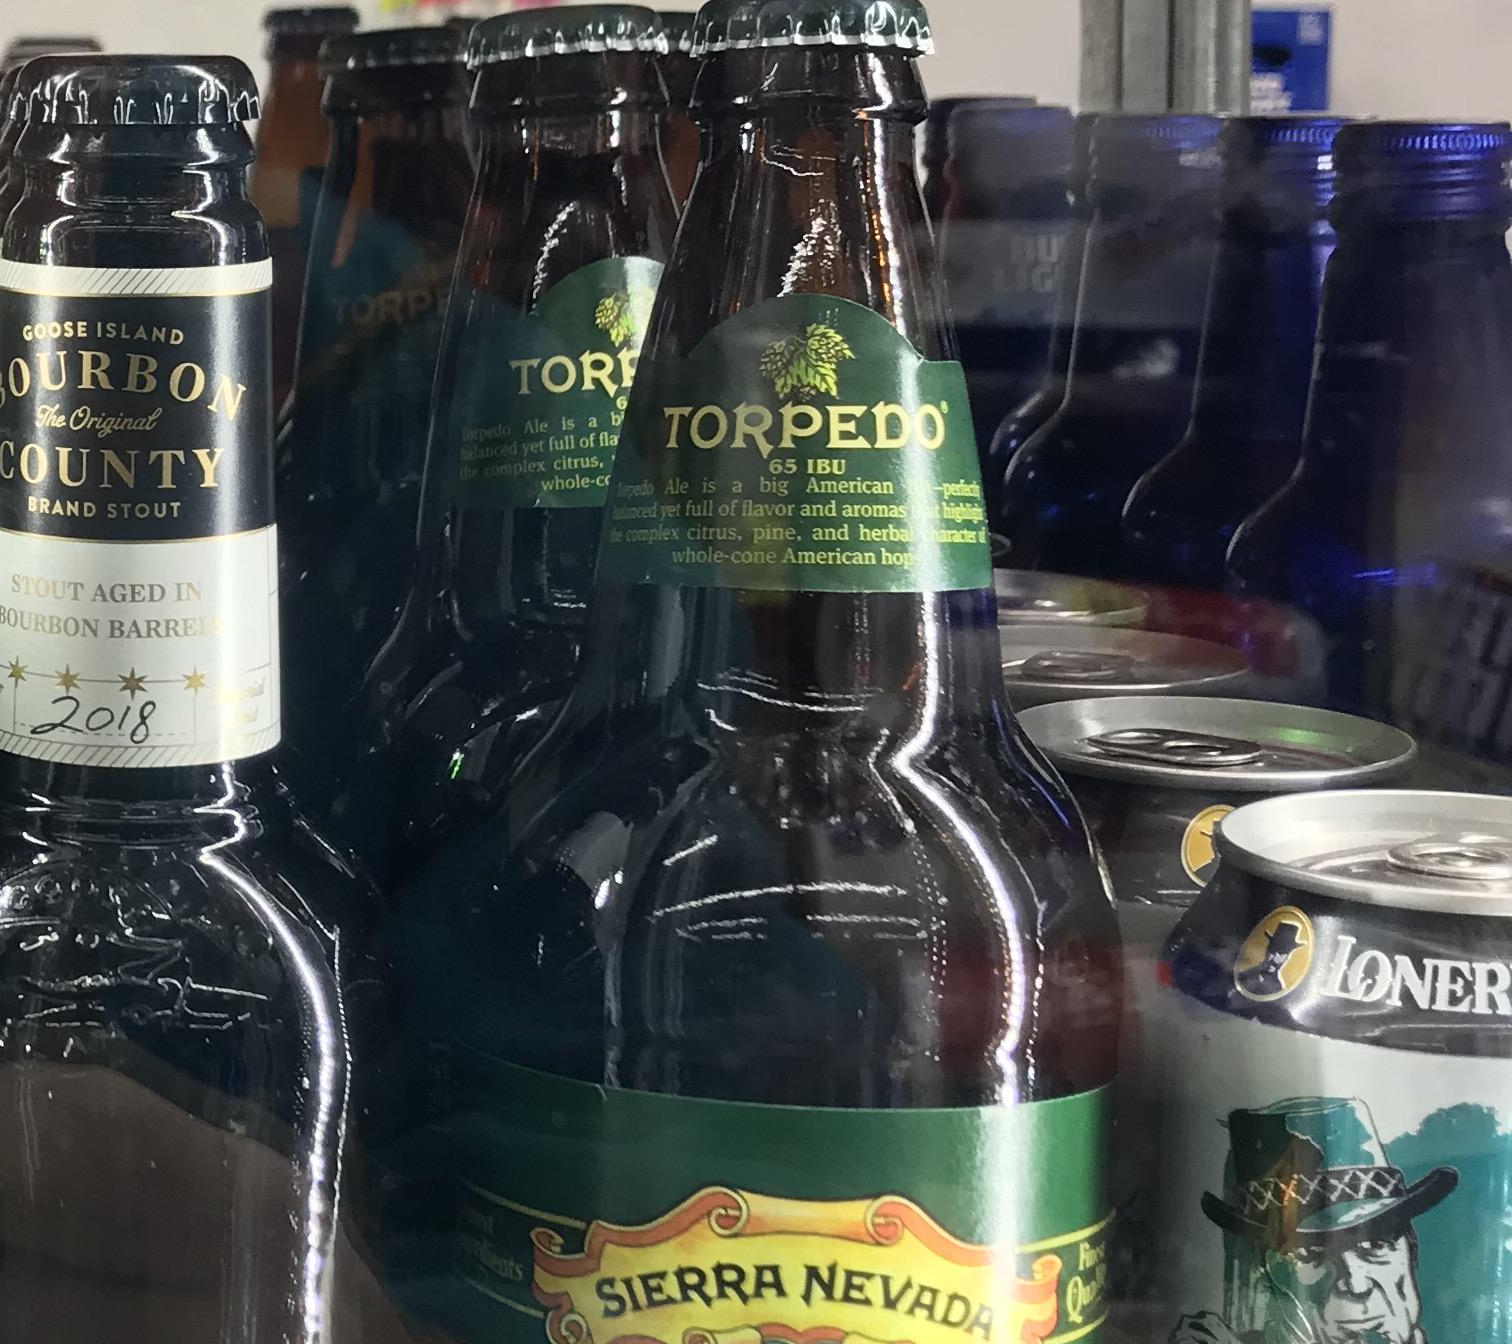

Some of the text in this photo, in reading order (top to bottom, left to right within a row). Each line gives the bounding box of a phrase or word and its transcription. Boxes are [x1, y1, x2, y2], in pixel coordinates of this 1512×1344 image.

[22, 320, 185, 346] GOOSE ISLAND
[509, 346, 638, 398] TORP
[36, 404, 163, 438] The Original
[523, 418, 548, 434] Ale
[663, 400, 945, 460] TORPEDO
[548, 432, 597, 452] full of
[553, 455, 605, 471] citrus,
[769, 459, 847, 476] 65 IBU
[664, 476, 894, 497] Ale is big American
[28, 496, 182, 521] BRAND STOUT
[684, 500, 907, 519] full of flavor and aromas
[687, 525, 850, 544] citrus, pine, and
[671, 546, 877, 565] whole-cone American
[11, 573, 204, 604] STOUT AGED IN
[29, 694, 157, 744] 2018
[1324, 934, 1512, 1015] LONER
[595, 1262, 995, 1342] SIERRA NEVADA
